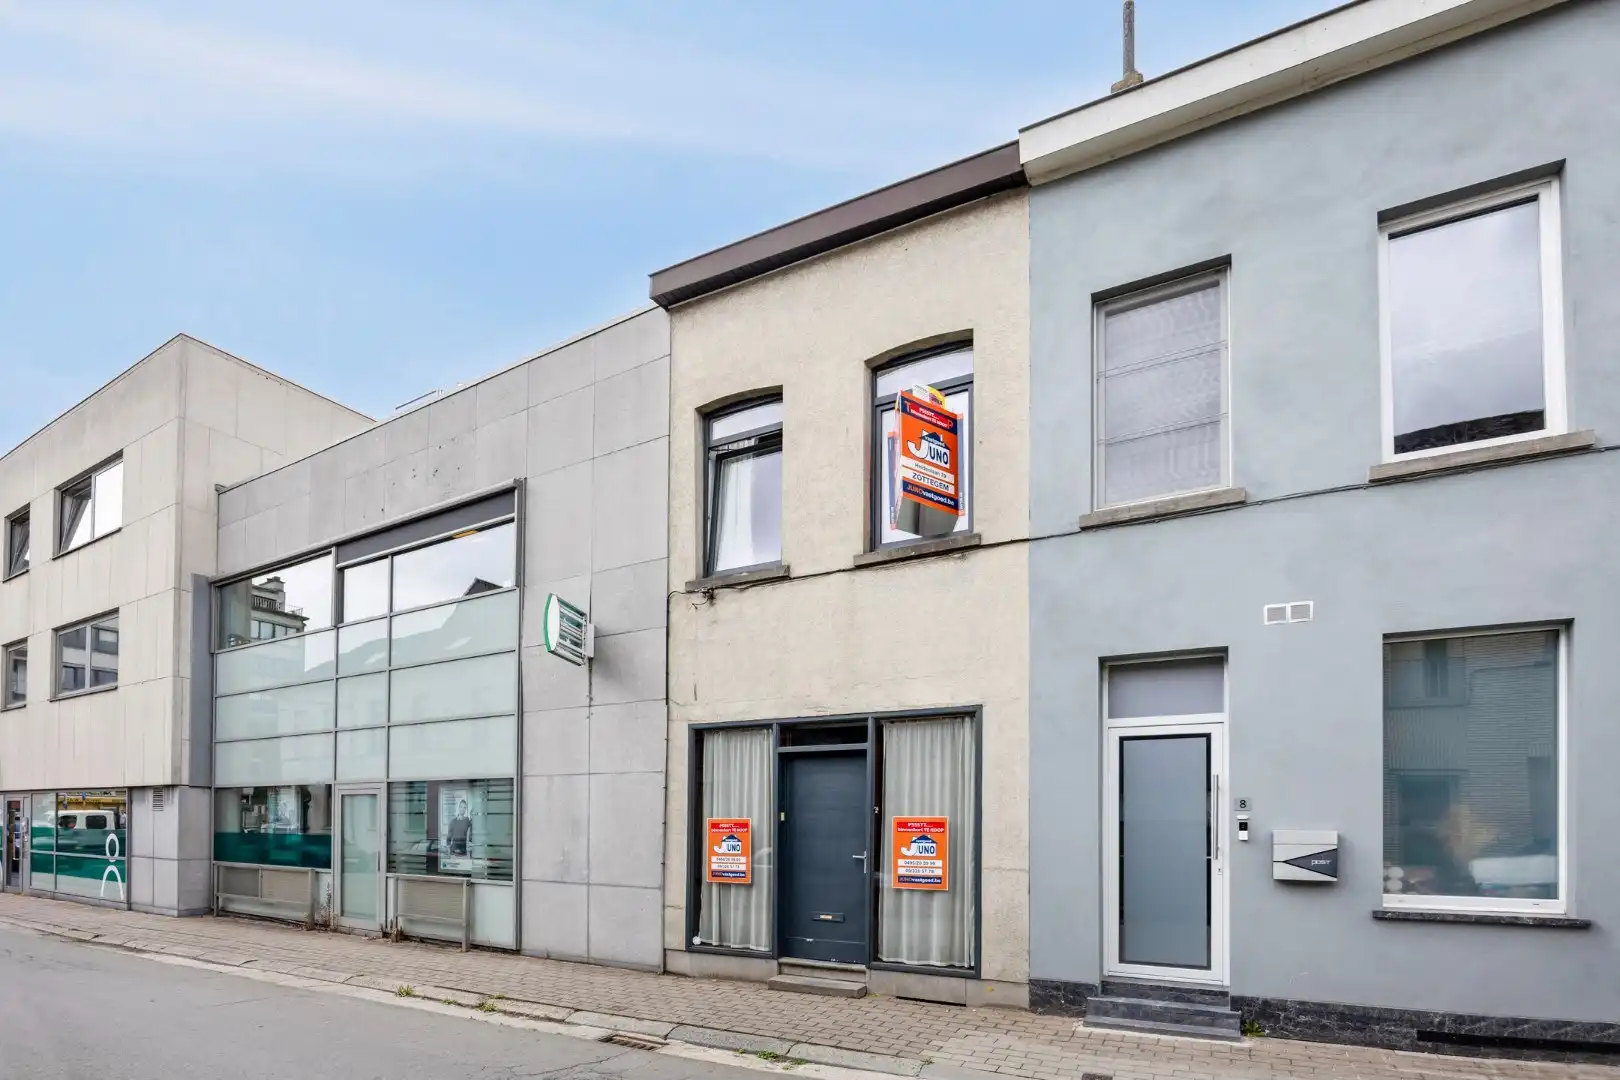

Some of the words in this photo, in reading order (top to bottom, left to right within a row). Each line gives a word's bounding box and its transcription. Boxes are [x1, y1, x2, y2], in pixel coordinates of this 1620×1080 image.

[907, 429, 949, 465] JUNO
[912, 472, 950, 491] ZOTTEGEM
[907, 484, 955, 506] JUNOvastgoed.be
[1239, 799, 1247, 809] 8
[713, 835, 741, 854] JUNO
[900, 836, 936, 857] JUNO
